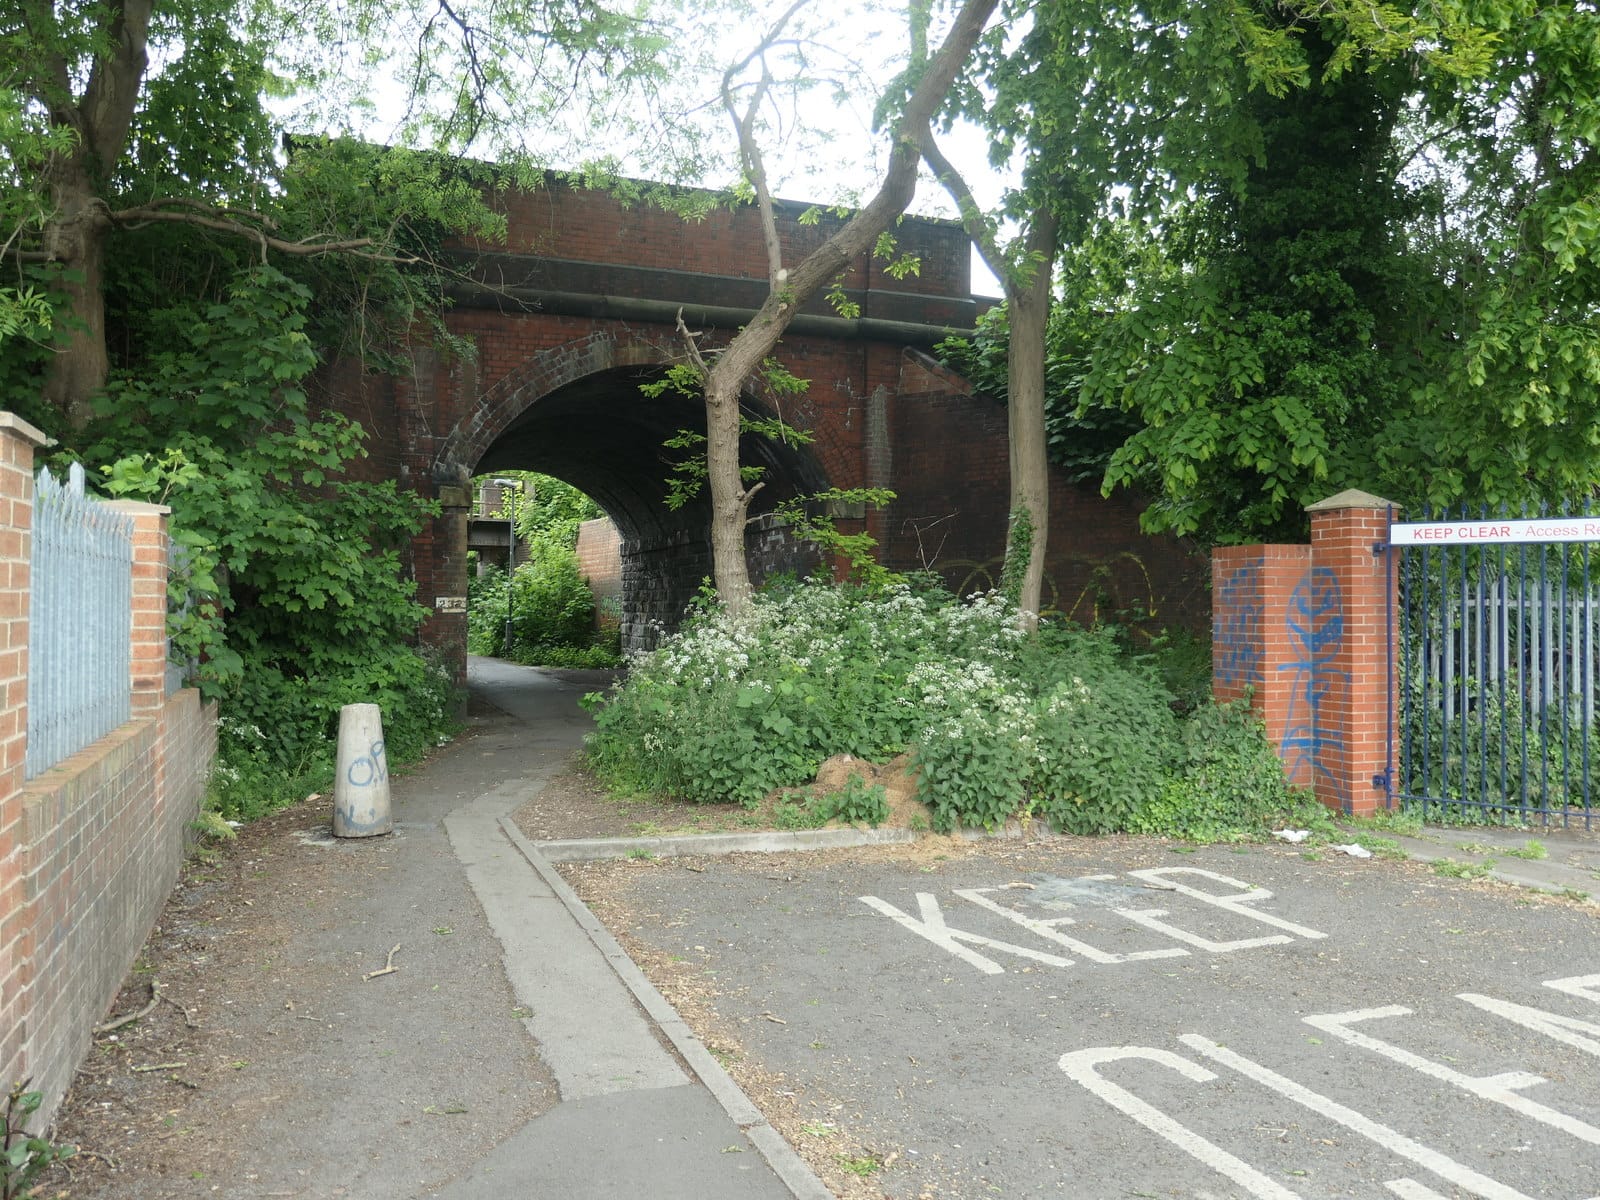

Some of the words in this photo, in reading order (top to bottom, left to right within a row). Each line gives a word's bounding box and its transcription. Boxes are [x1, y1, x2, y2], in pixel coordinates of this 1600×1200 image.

[1413, 527, 1453, 540] KEEP
[1458, 526, 1511, 539] CLEAR
[1525, 525, 1579, 537] Access
[858, 866, 1328, 974] KEEP
